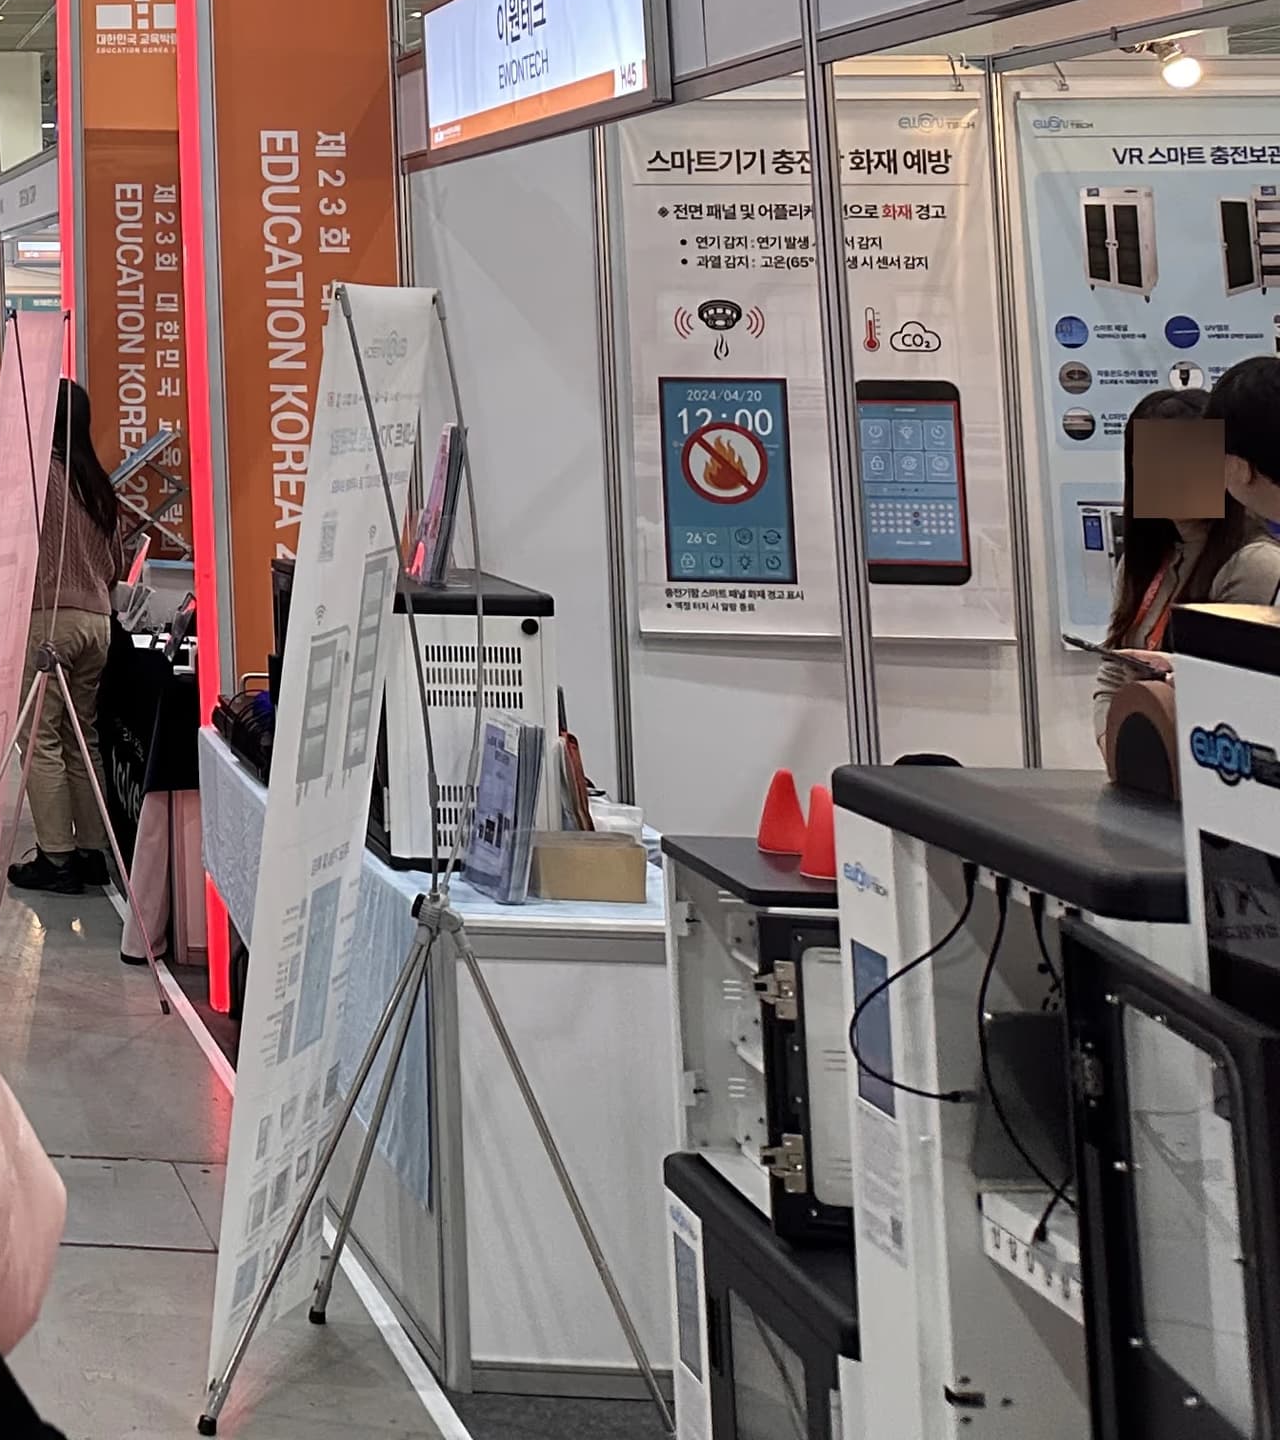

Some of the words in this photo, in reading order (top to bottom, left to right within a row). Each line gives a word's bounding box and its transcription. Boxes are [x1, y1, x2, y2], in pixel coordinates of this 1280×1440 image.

[96, 33, 137, 46] 대한민국
[498, 48, 549, 90] EWONTECH
[620, 63, 637, 89] H45
[646, 149, 766, 175] 스마트기기
[848, 148, 898, 175] 화재
[903, 148, 953, 175] 예방
[1112, 147, 1144, 165] VR
[1148, 146, 1205, 165] 스마트
[1209, 145, 1280, 166] 충전보관
[313, 130, 351, 254] 제23회
[673, 203, 703, 220] 전면
[706, 203, 737, 220] 패널
[740, 203, 755, 220] 및
[881, 203, 912, 221] 화재
[915, 203, 947, 220] 경고
[153, 183, 179, 271] 제23회
[260, 130, 308, 370] EDUCATION
[695, 235, 721, 249] 연기
[724, 235, 748, 249] 감지
[757, 235, 782, 249] 연기
[784, 235, 809, 249] 발생
[857, 235, 883, 250] 감지
[114, 183, 146, 355] EDUCATION
[696, 255, 721, 269] 과열
[724, 255, 749, 269] 감지
[861, 255, 873, 270] 시
[876, 255, 901, 270] 센서
[904, 255, 929, 270] 감지
[155, 291, 181, 398] 대한민국
[686, 389, 763, 402] 2024/04/20
[117, 363, 148, 464] KOREA
[677, 407, 773, 436] 12:00
[269, 384, 311, 530] KOREA
[701, 589, 728, 599] 스마트
